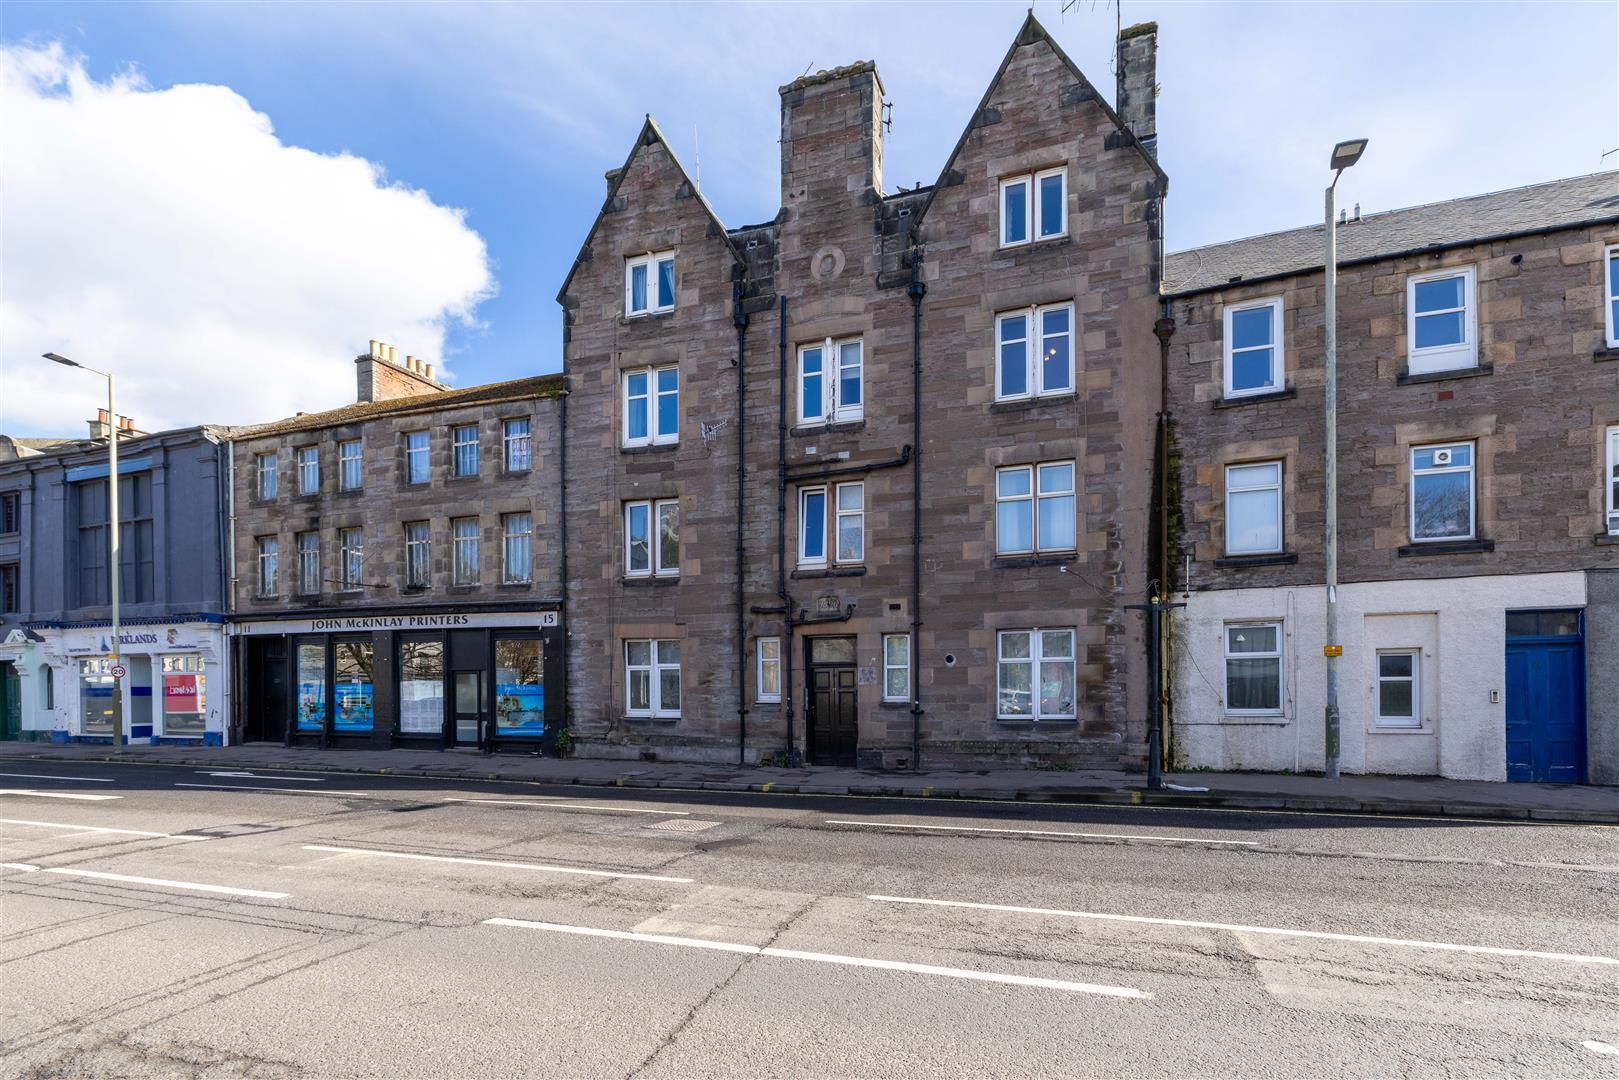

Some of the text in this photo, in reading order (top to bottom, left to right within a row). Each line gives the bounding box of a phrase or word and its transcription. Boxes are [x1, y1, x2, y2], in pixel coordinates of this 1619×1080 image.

[311, 615, 468, 631] JOHN McKINLAY PRINTERS
[543, 614, 554, 624] 15
[111, 634, 158, 645] RKLANDS
